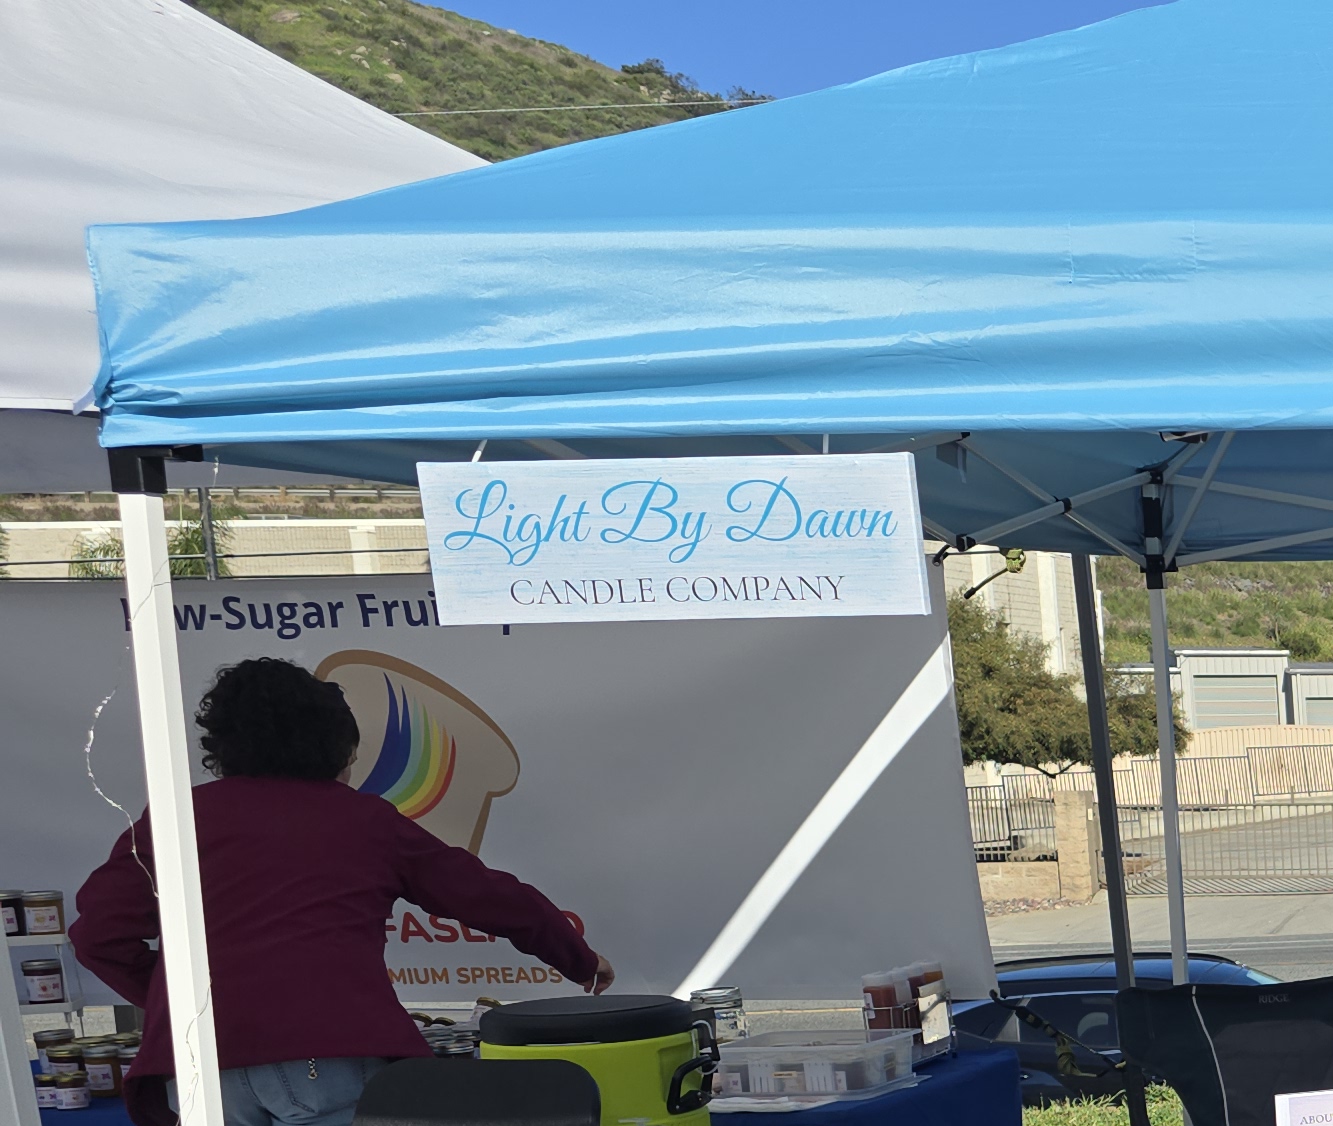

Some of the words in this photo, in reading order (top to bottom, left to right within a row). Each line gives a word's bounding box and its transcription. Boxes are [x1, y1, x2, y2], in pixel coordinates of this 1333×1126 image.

[443, 479, 591, 567] Light
[600, 477, 712, 563] By
[725, 476, 898, 543] Dawn
[510, 577, 656, 607] CANDLE
[666, 575, 845, 604] COMPANY
[121, 596, 340, 639] w-Sugar
[356, 593, 440, 628] Frui
[388, 968, 450, 985] MIUM
[457, 967, 563, 984] SPREADS
